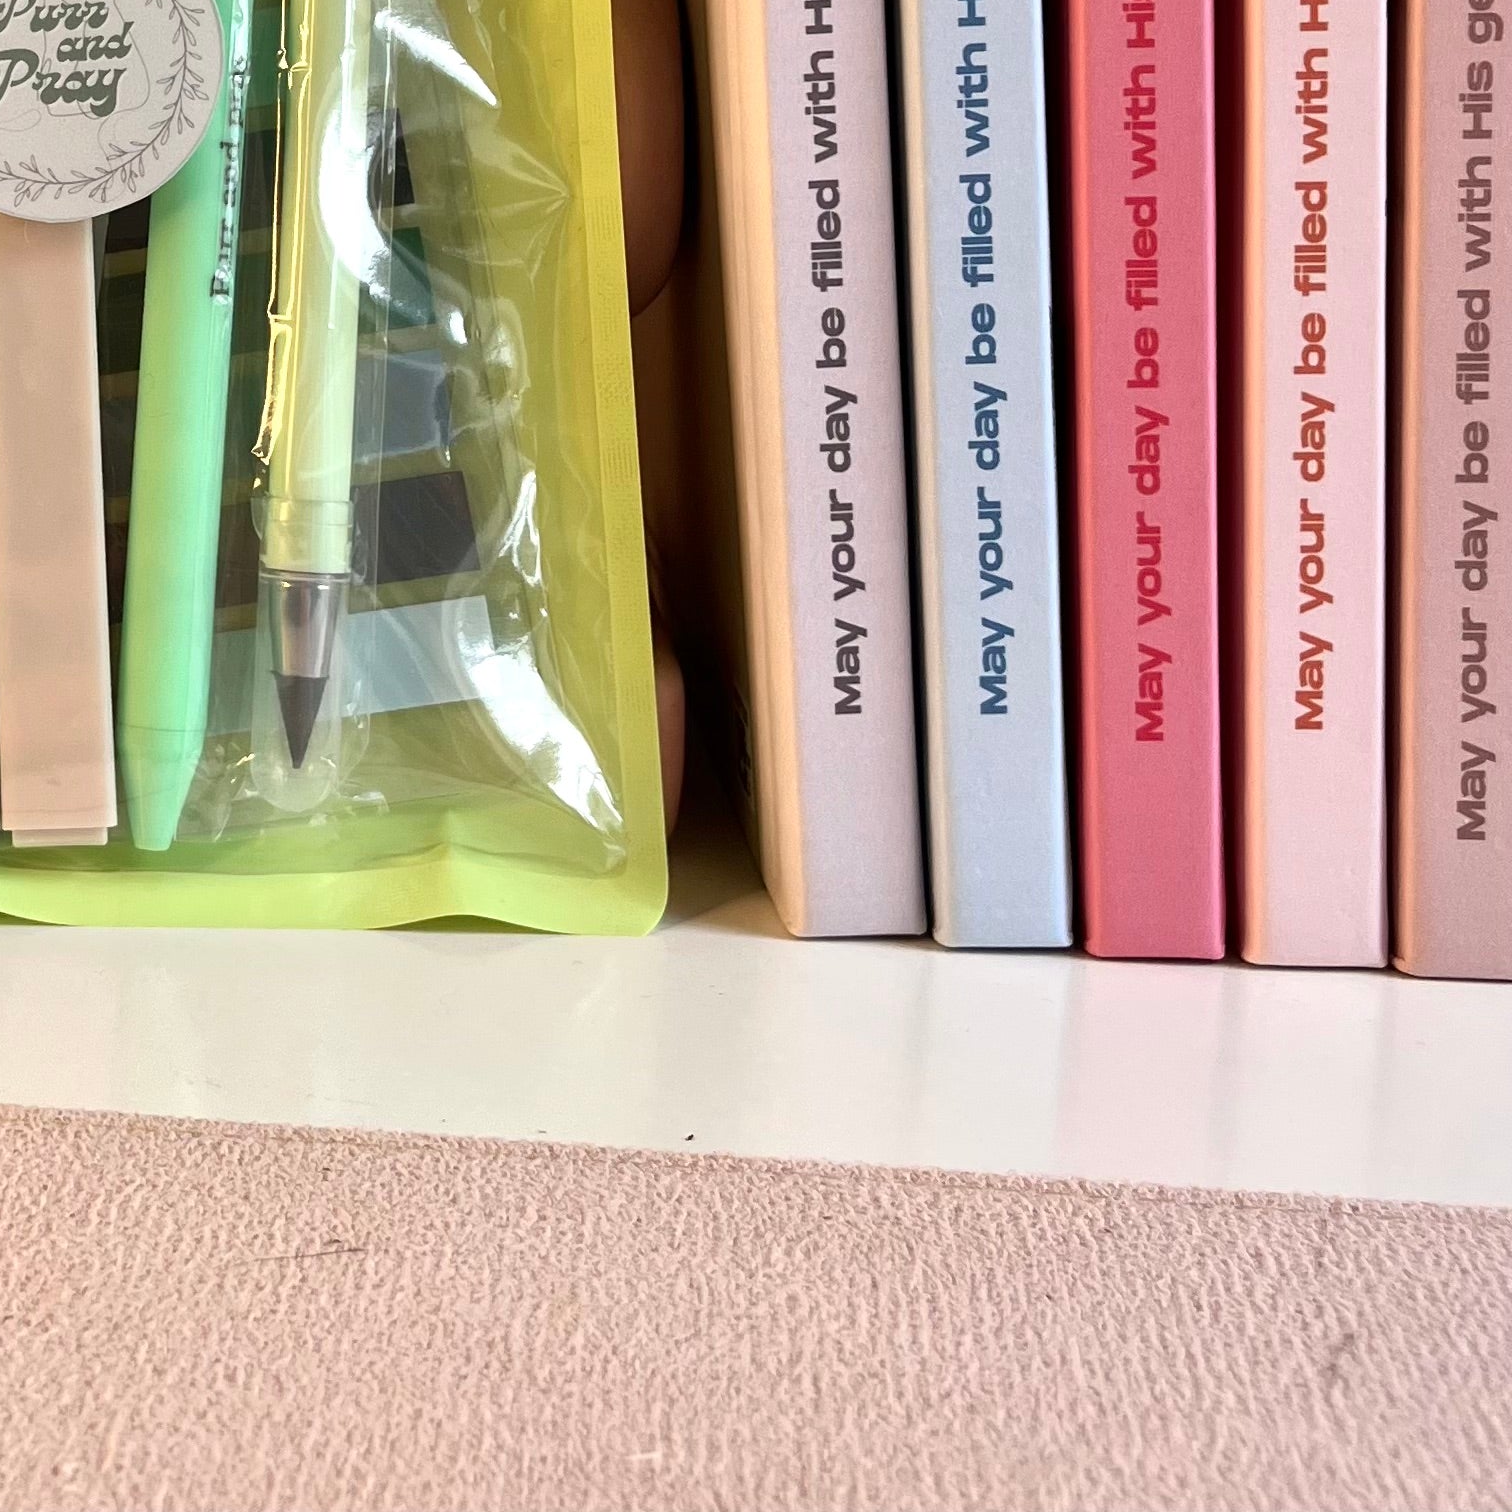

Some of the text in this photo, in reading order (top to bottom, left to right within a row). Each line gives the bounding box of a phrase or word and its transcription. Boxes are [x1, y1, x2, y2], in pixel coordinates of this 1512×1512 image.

[56, 21, 135, 62] and
[803, 50, 838, 163] with
[956, 43, 990, 157] with
[1123, 64, 1157, 180] with
[1295, 48, 1328, 164] with
[1459, 61, 1493, 139] His
[808, 179, 843, 292] filled
[959, 174, 994, 288] filled
[1124, 196, 1159, 311] filled
[1294, 181, 1327, 297] filled
[1458, 156, 1492, 272] with
[816, 308, 847, 369] be
[965, 303, 997, 365] be
[1127, 327, 1160, 388] be
[1293, 313, 1326, 375] be
[1456, 289, 1490, 405] filled
[820, 385, 858, 473] day
[968, 381, 1008, 470] day
[1128, 405, 1169, 495] day
[1293, 392, 1335, 482] day
[1455, 421, 1489, 483] be
[829, 489, 866, 601] your
[977, 486, 1014, 600] your
[1136, 511, 1172, 626] your
[1299, 498, 1333, 614] your
[1454, 500, 1498, 591] day
[834, 618, 868, 715] May
[979, 617, 1014, 715] May
[1135, 643, 1172, 741] May
[1295, 631, 1333, 730] May
[1461, 607, 1496, 723] your
[1456, 741, 1496, 841] May
